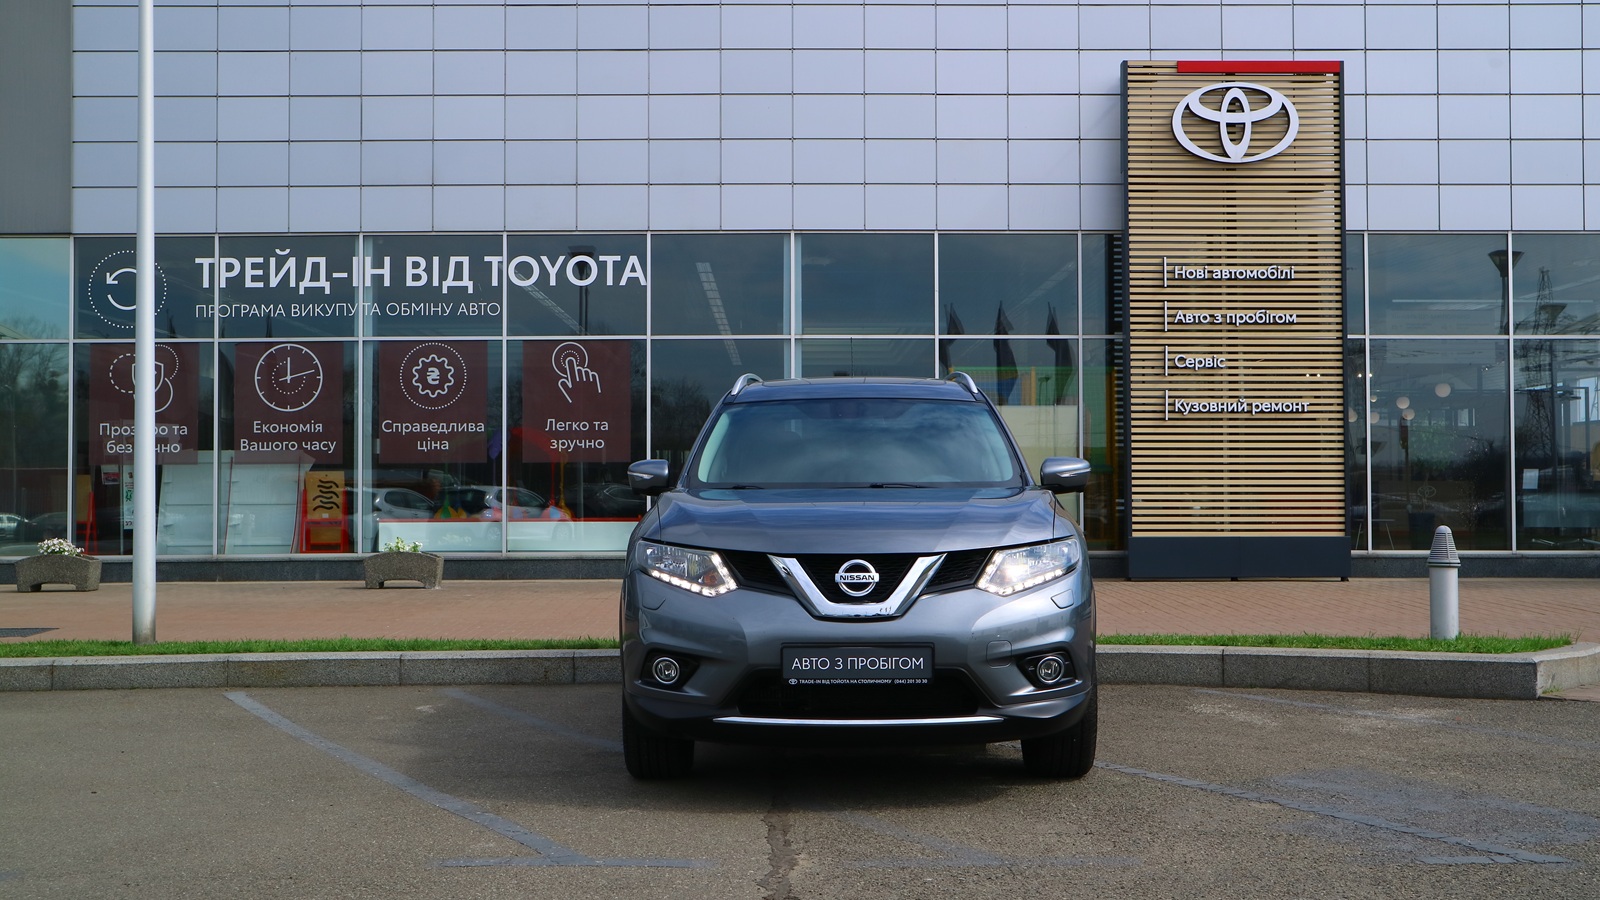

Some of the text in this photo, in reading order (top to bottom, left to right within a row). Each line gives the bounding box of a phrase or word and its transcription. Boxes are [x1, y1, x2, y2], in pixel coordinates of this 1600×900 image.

[195, 248, 648, 295] ТРЕЙД-ІН ВІД TOYOTA
[1174, 265, 1295, 279] Нові автомобілі
[195, 302, 501, 318] ПРОГРАМА ВИКУПУ ТА ОБМІНУ АВТО
[1174, 309, 1297, 327] Авто з пробігом
[1174, 354, 1226, 371] Сервіс
[1174, 398, 1310, 416] Кузовний ремонт
[172, 425, 188, 435] та
[253, 420, 323, 433] Економія
[381, 419, 485, 435] Справедлива
[545, 418, 609, 431] Легко та
[240, 438, 337, 454] Вашого часу
[417, 437, 449, 452] ціна
[550, 439, 605, 453] зручно
[791, 657, 924, 670] АВТО З ПРОБІГОМ
